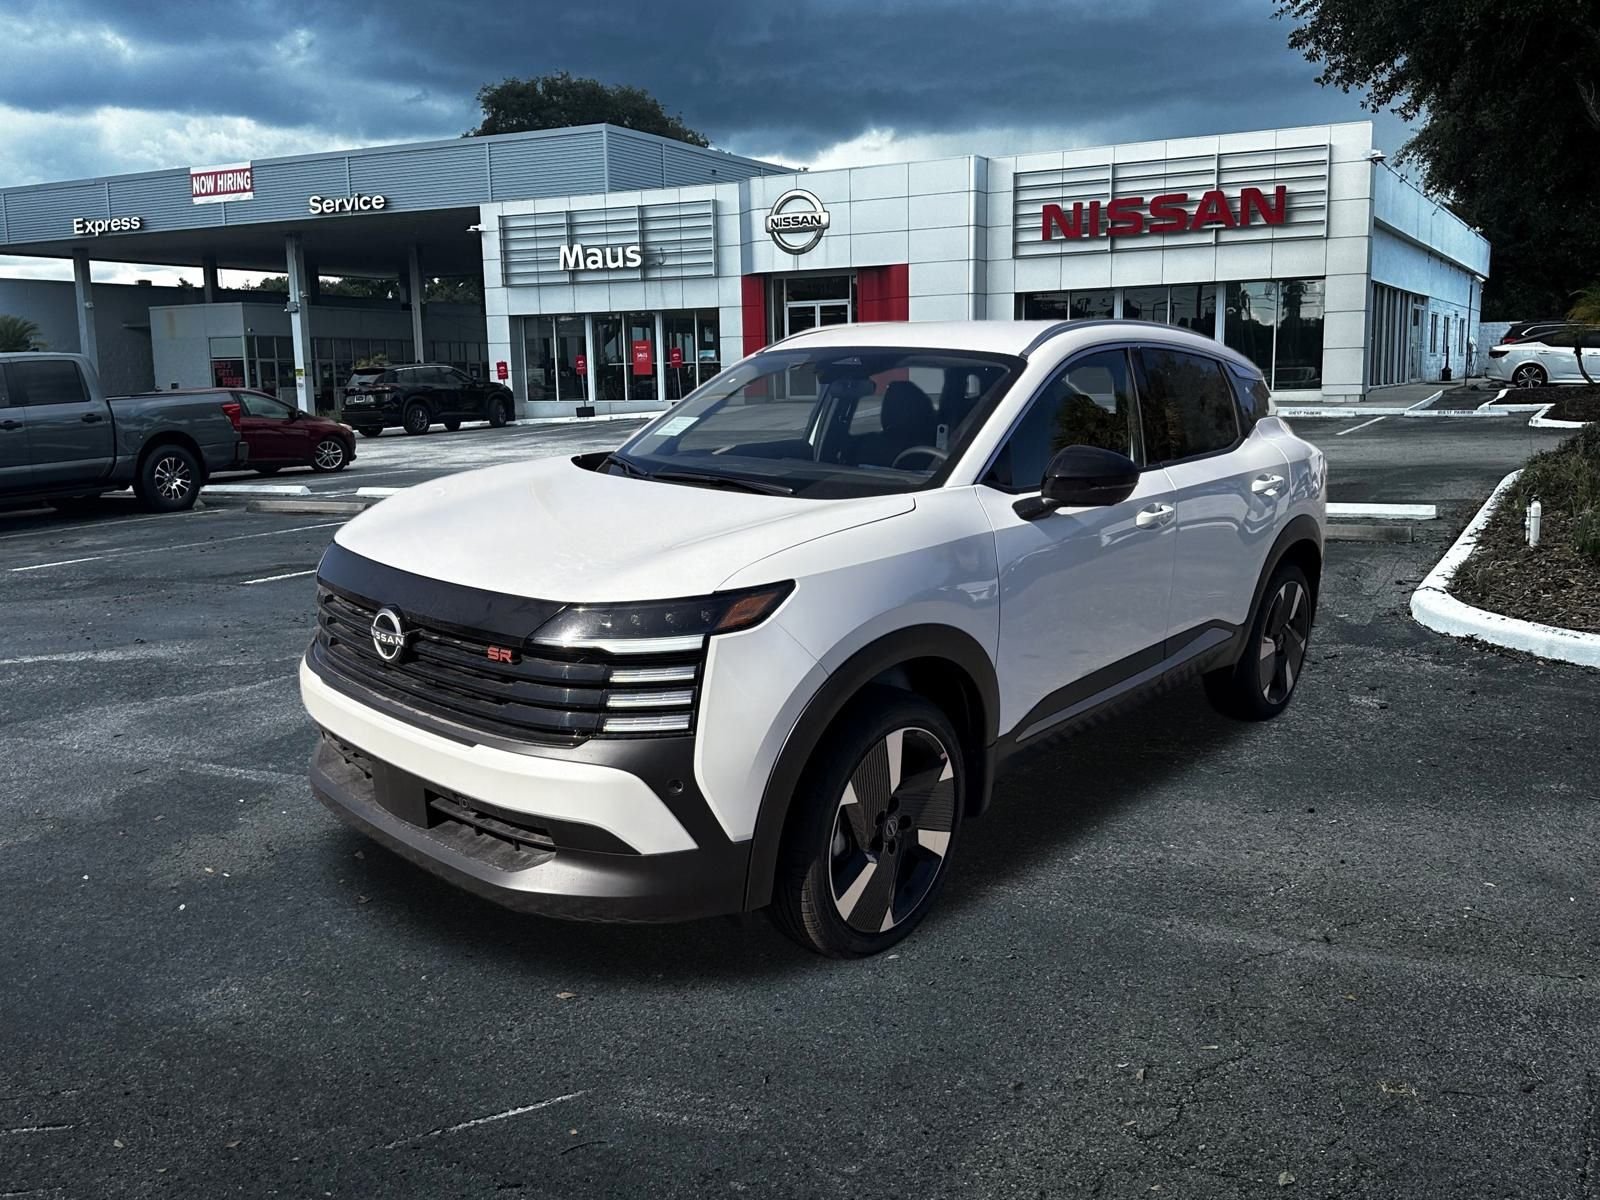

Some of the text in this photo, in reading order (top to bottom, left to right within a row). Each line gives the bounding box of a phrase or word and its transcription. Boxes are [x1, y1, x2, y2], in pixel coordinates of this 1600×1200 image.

[192, 171, 251, 195] NOW HIRING
[308, 192, 385, 214] Service
[1042, 185, 1287, 241] NISSAN
[73, 216, 141, 236] Express
[770, 214, 822, 228] NISSAN
[559, 243, 642, 271] Maus
[373, 631, 404, 646] SSAN
[487, 646, 512, 663] SR
